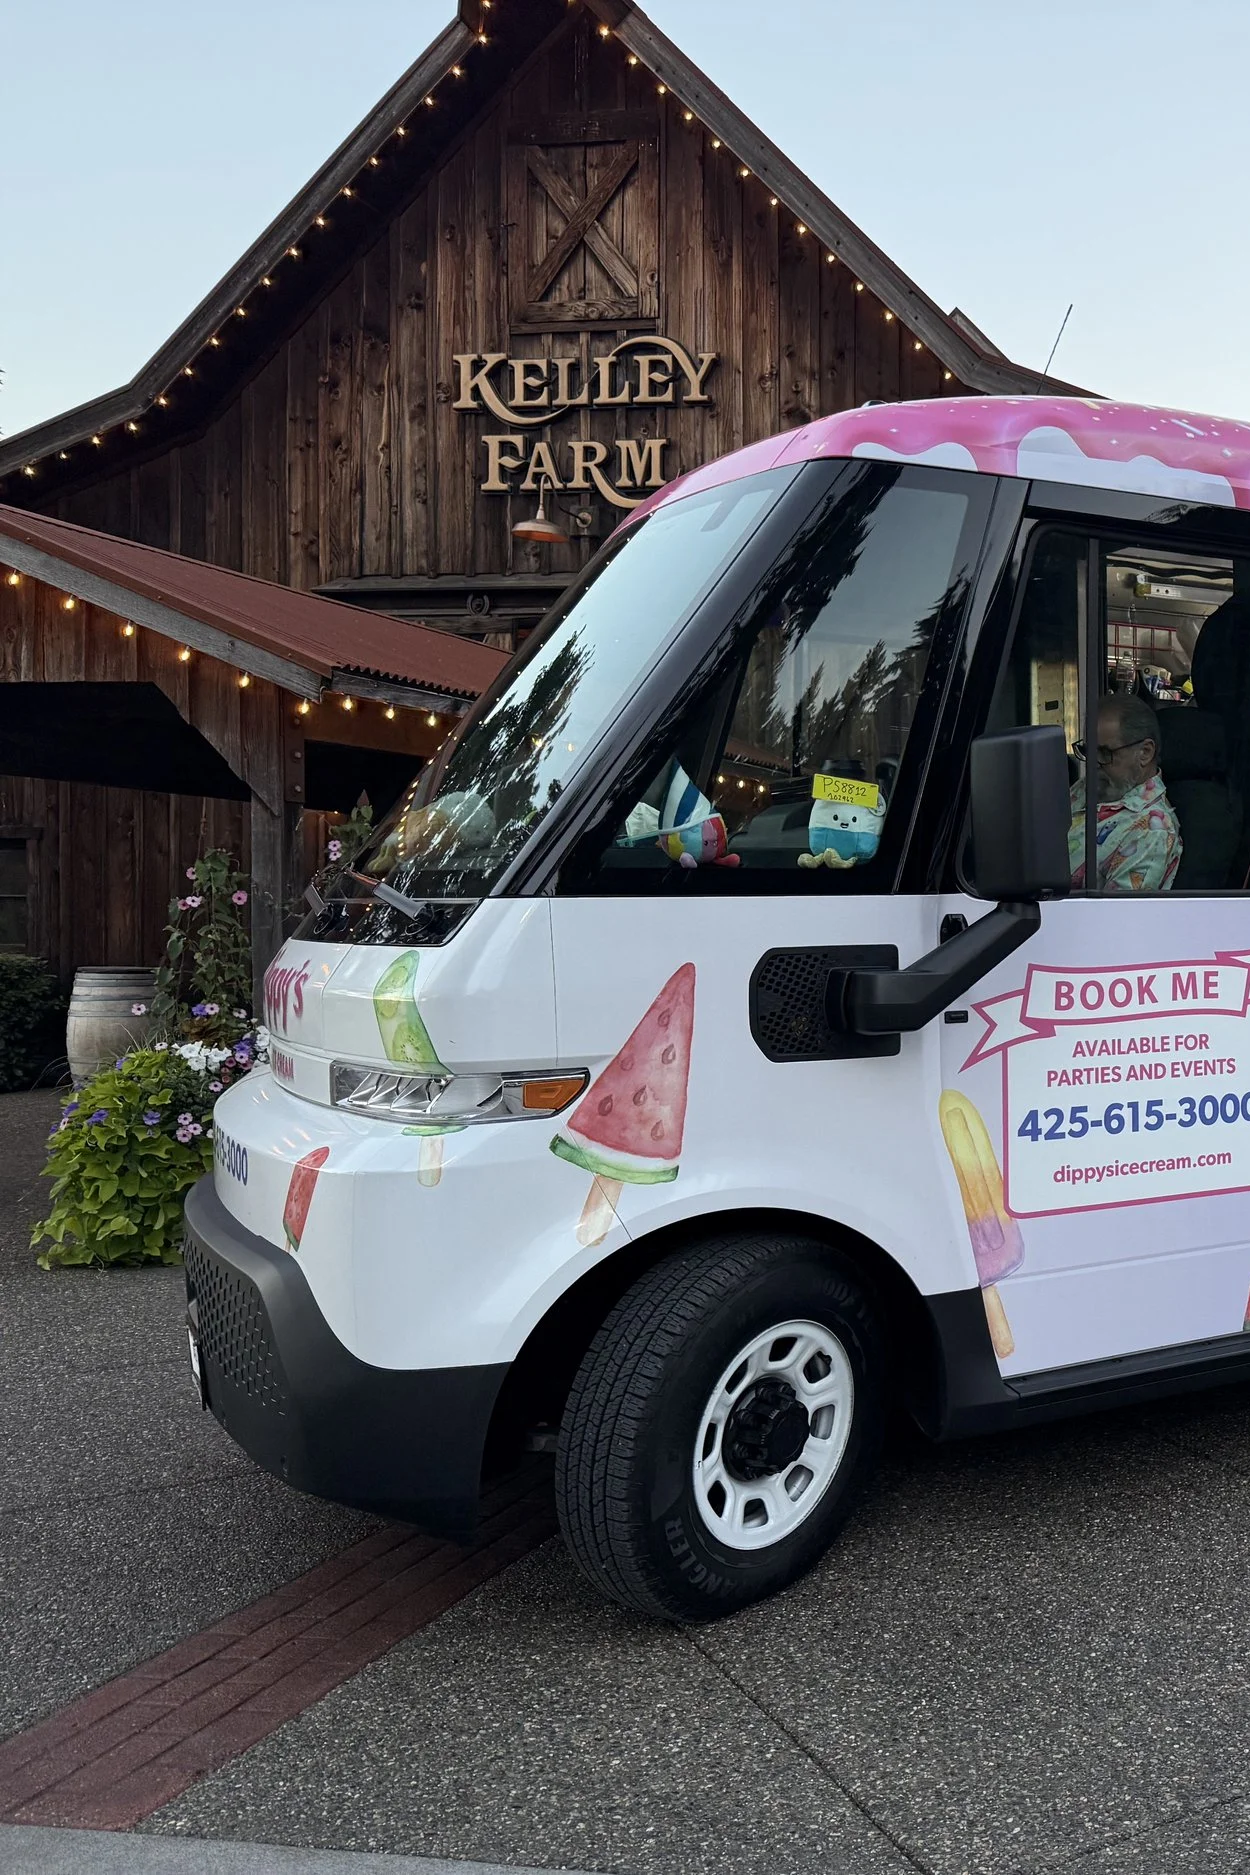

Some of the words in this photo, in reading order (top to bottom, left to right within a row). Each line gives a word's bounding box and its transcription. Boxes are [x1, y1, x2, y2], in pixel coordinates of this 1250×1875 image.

[452, 335, 719, 425] KELLEY
[480, 434, 669, 508] FARM
[822, 777, 867, 797] PS8812
[1054, 974, 1158, 1011] BOOK
[1171, 970, 1220, 1001] ME
[1072, 1035, 1171, 1058] AVAILABLE
[1174, 1033, 1210, 1052] FOR
[1047, 1065, 1122, 1088] PARTIES
[1126, 1062, 1167, 1083] AND
[1170, 1057, 1236, 1079] EVENTS
[1053, 1151, 1232, 1185] dippysicecream.com
